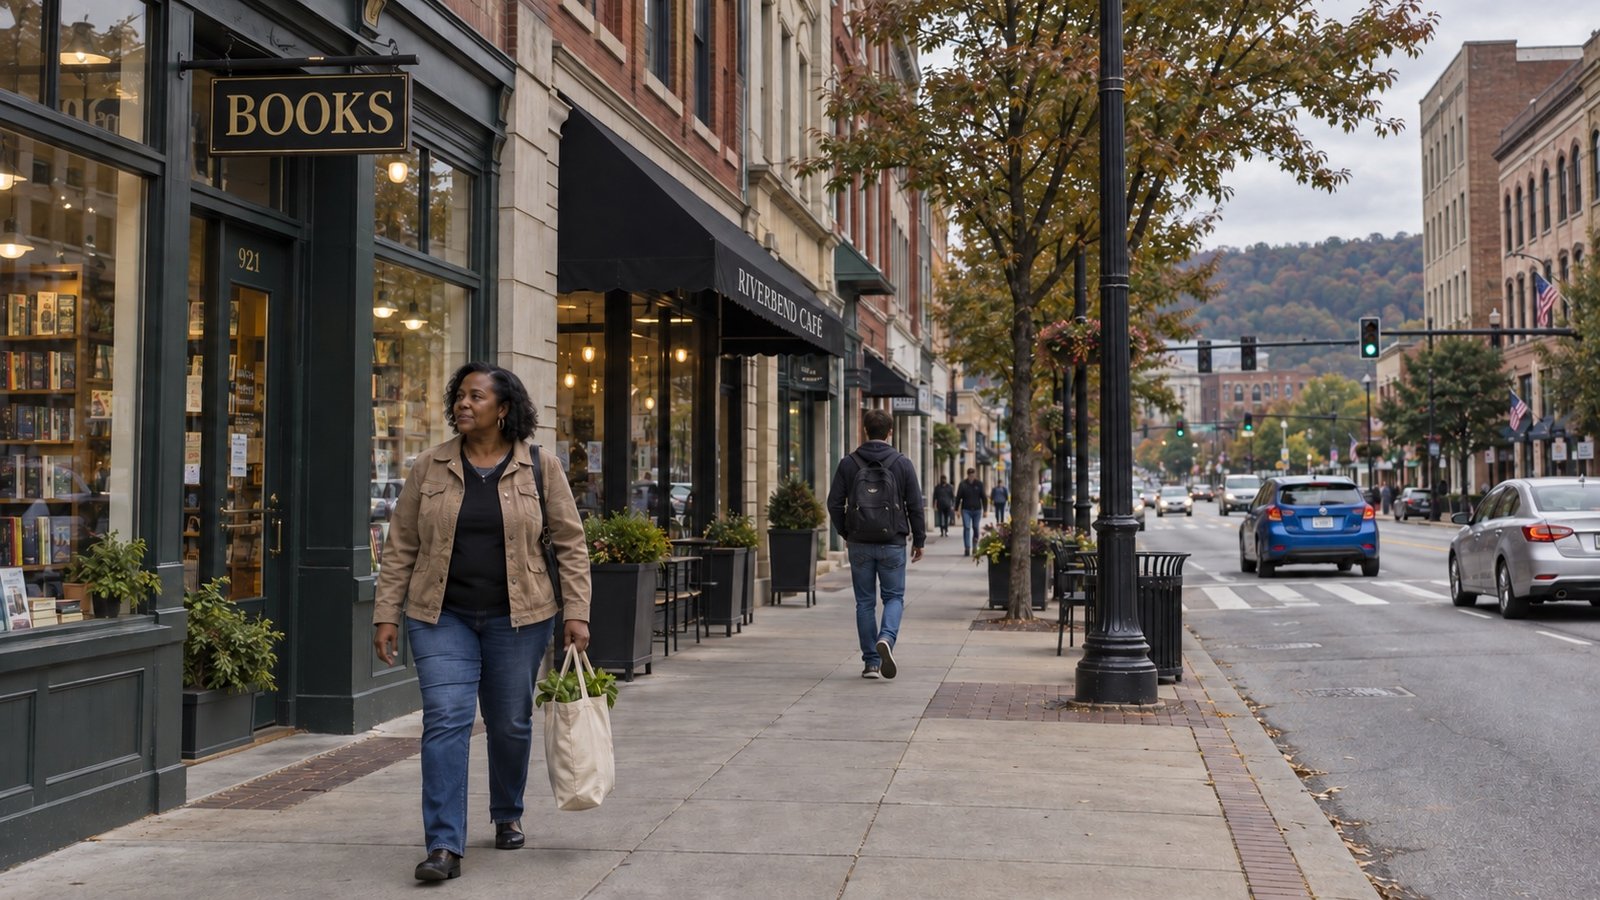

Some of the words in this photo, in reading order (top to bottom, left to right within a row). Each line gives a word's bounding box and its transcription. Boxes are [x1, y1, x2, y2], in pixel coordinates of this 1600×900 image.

[226, 91, 394, 136] BOOKS
[238, 248, 261, 273] 921
[738, 267, 797, 323] RIVERBEND
[799, 308, 823, 338] CAFÉ
